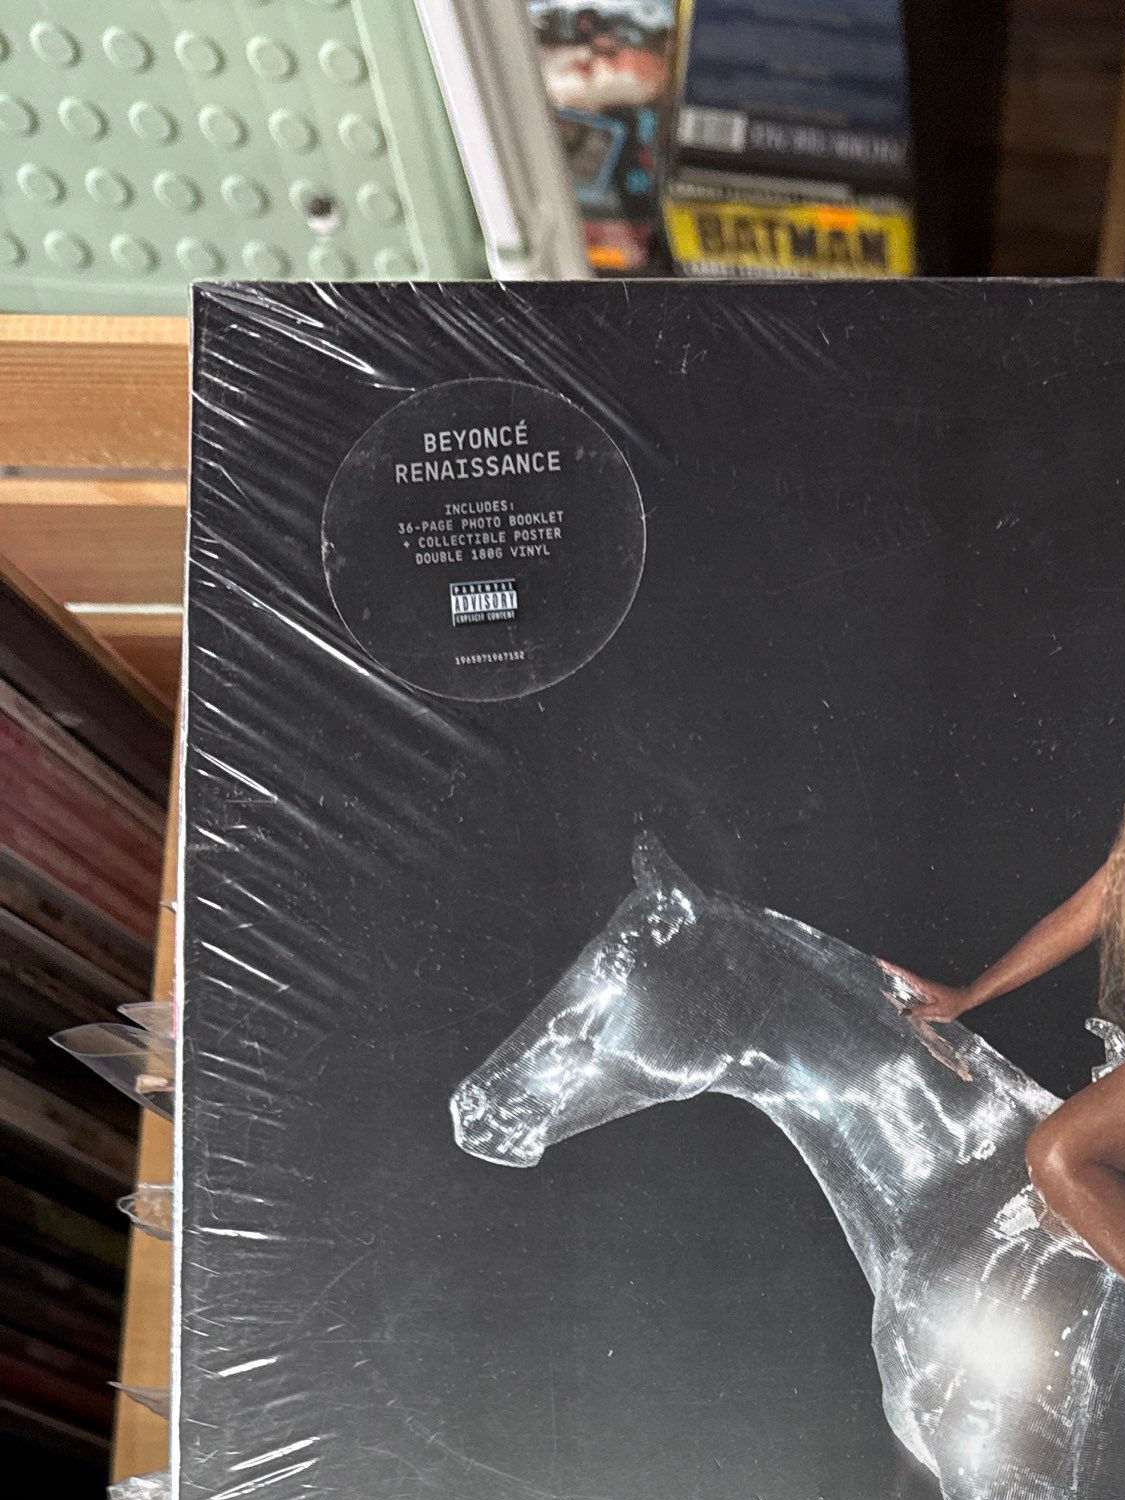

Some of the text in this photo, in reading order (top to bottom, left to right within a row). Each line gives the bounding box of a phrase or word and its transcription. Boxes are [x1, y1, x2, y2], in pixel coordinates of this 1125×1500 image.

[697, 211, 887, 265] BATMAN
[424, 419, 528, 453] BEYONCÉ
[395, 450, 561, 484] RENAISSANCE
[445, 500, 514, 515] INCLUDES:
[398, 511, 564, 535] 36-PAGE PHOTO BOOKLET
[418, 531, 506, 549] COLLECTIBLE
[514, 527, 562, 542] POSTER
[416, 544, 550, 565] DOUBLE 180G VINYL
[454, 582, 513, 594] PARENTAL
[455, 593, 515, 612] ADVISORY
[456, 610, 515, 624] EXPLICIT CONTENT
